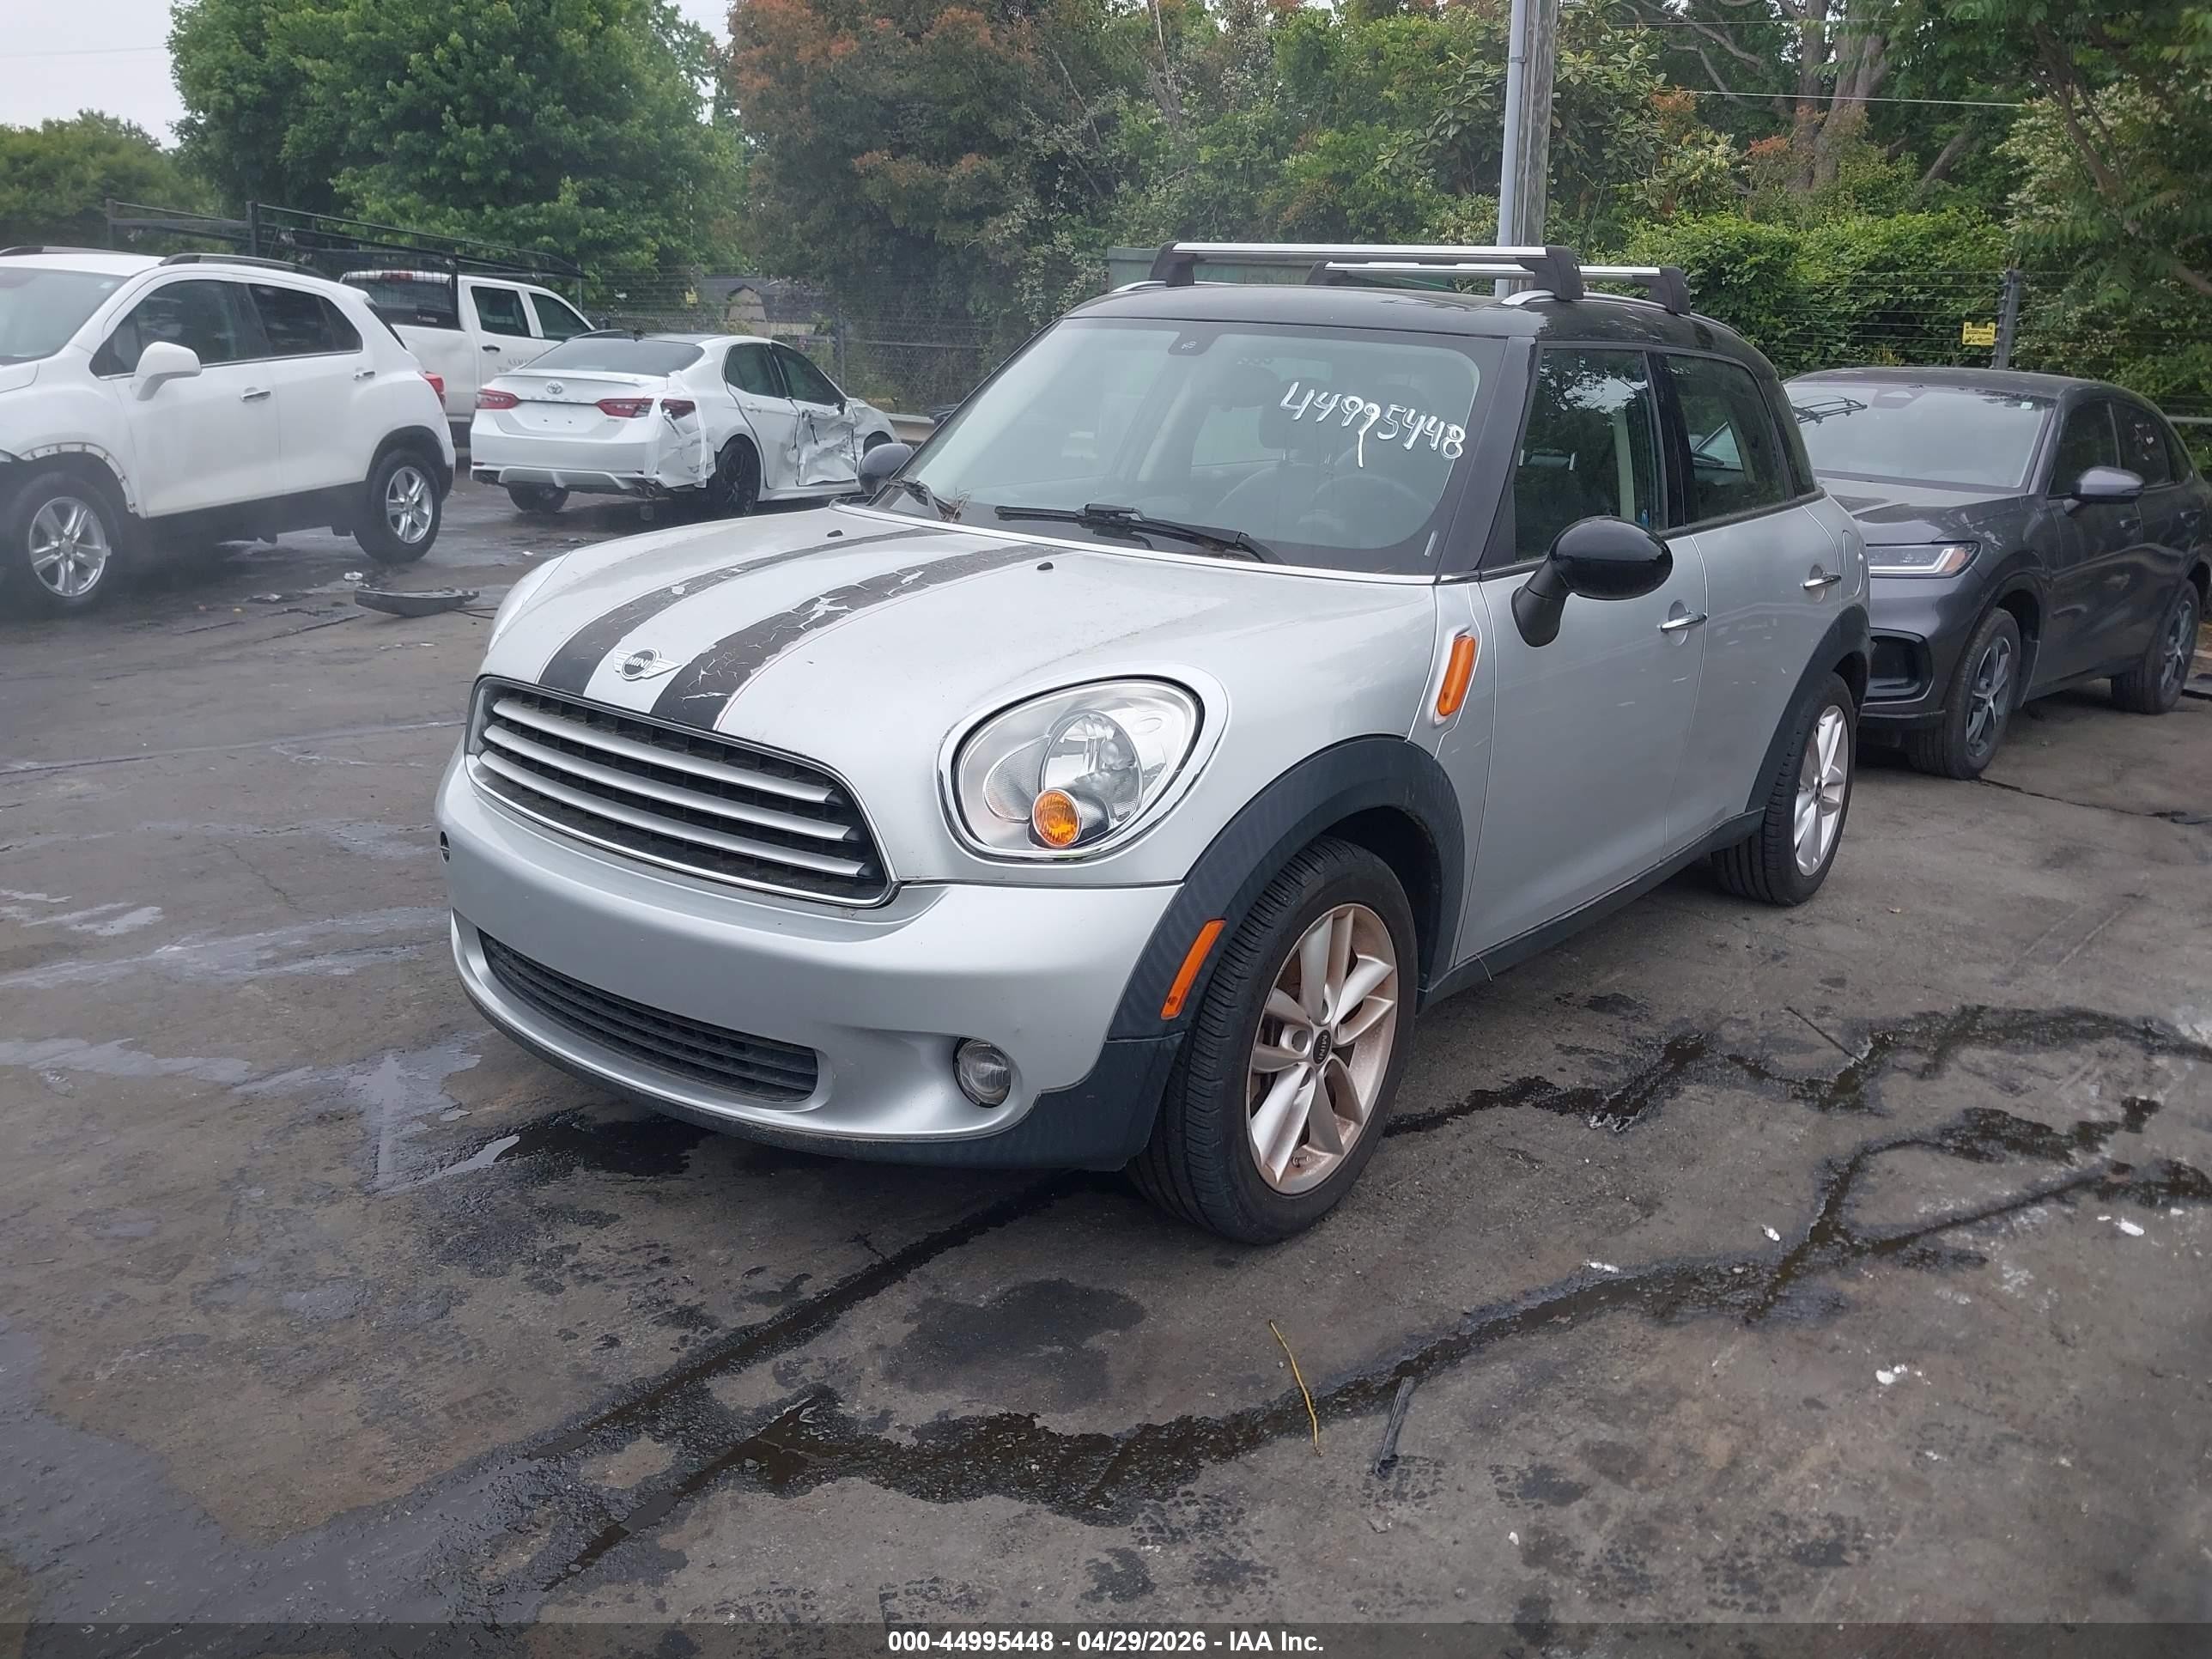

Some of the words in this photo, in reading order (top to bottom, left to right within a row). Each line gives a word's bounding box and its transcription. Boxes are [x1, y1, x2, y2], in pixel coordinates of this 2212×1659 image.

[1279, 381, 1466, 468] 44995448
[626, 656, 653, 670] MINI
[1317, 1034, 1328, 1060] MINI
